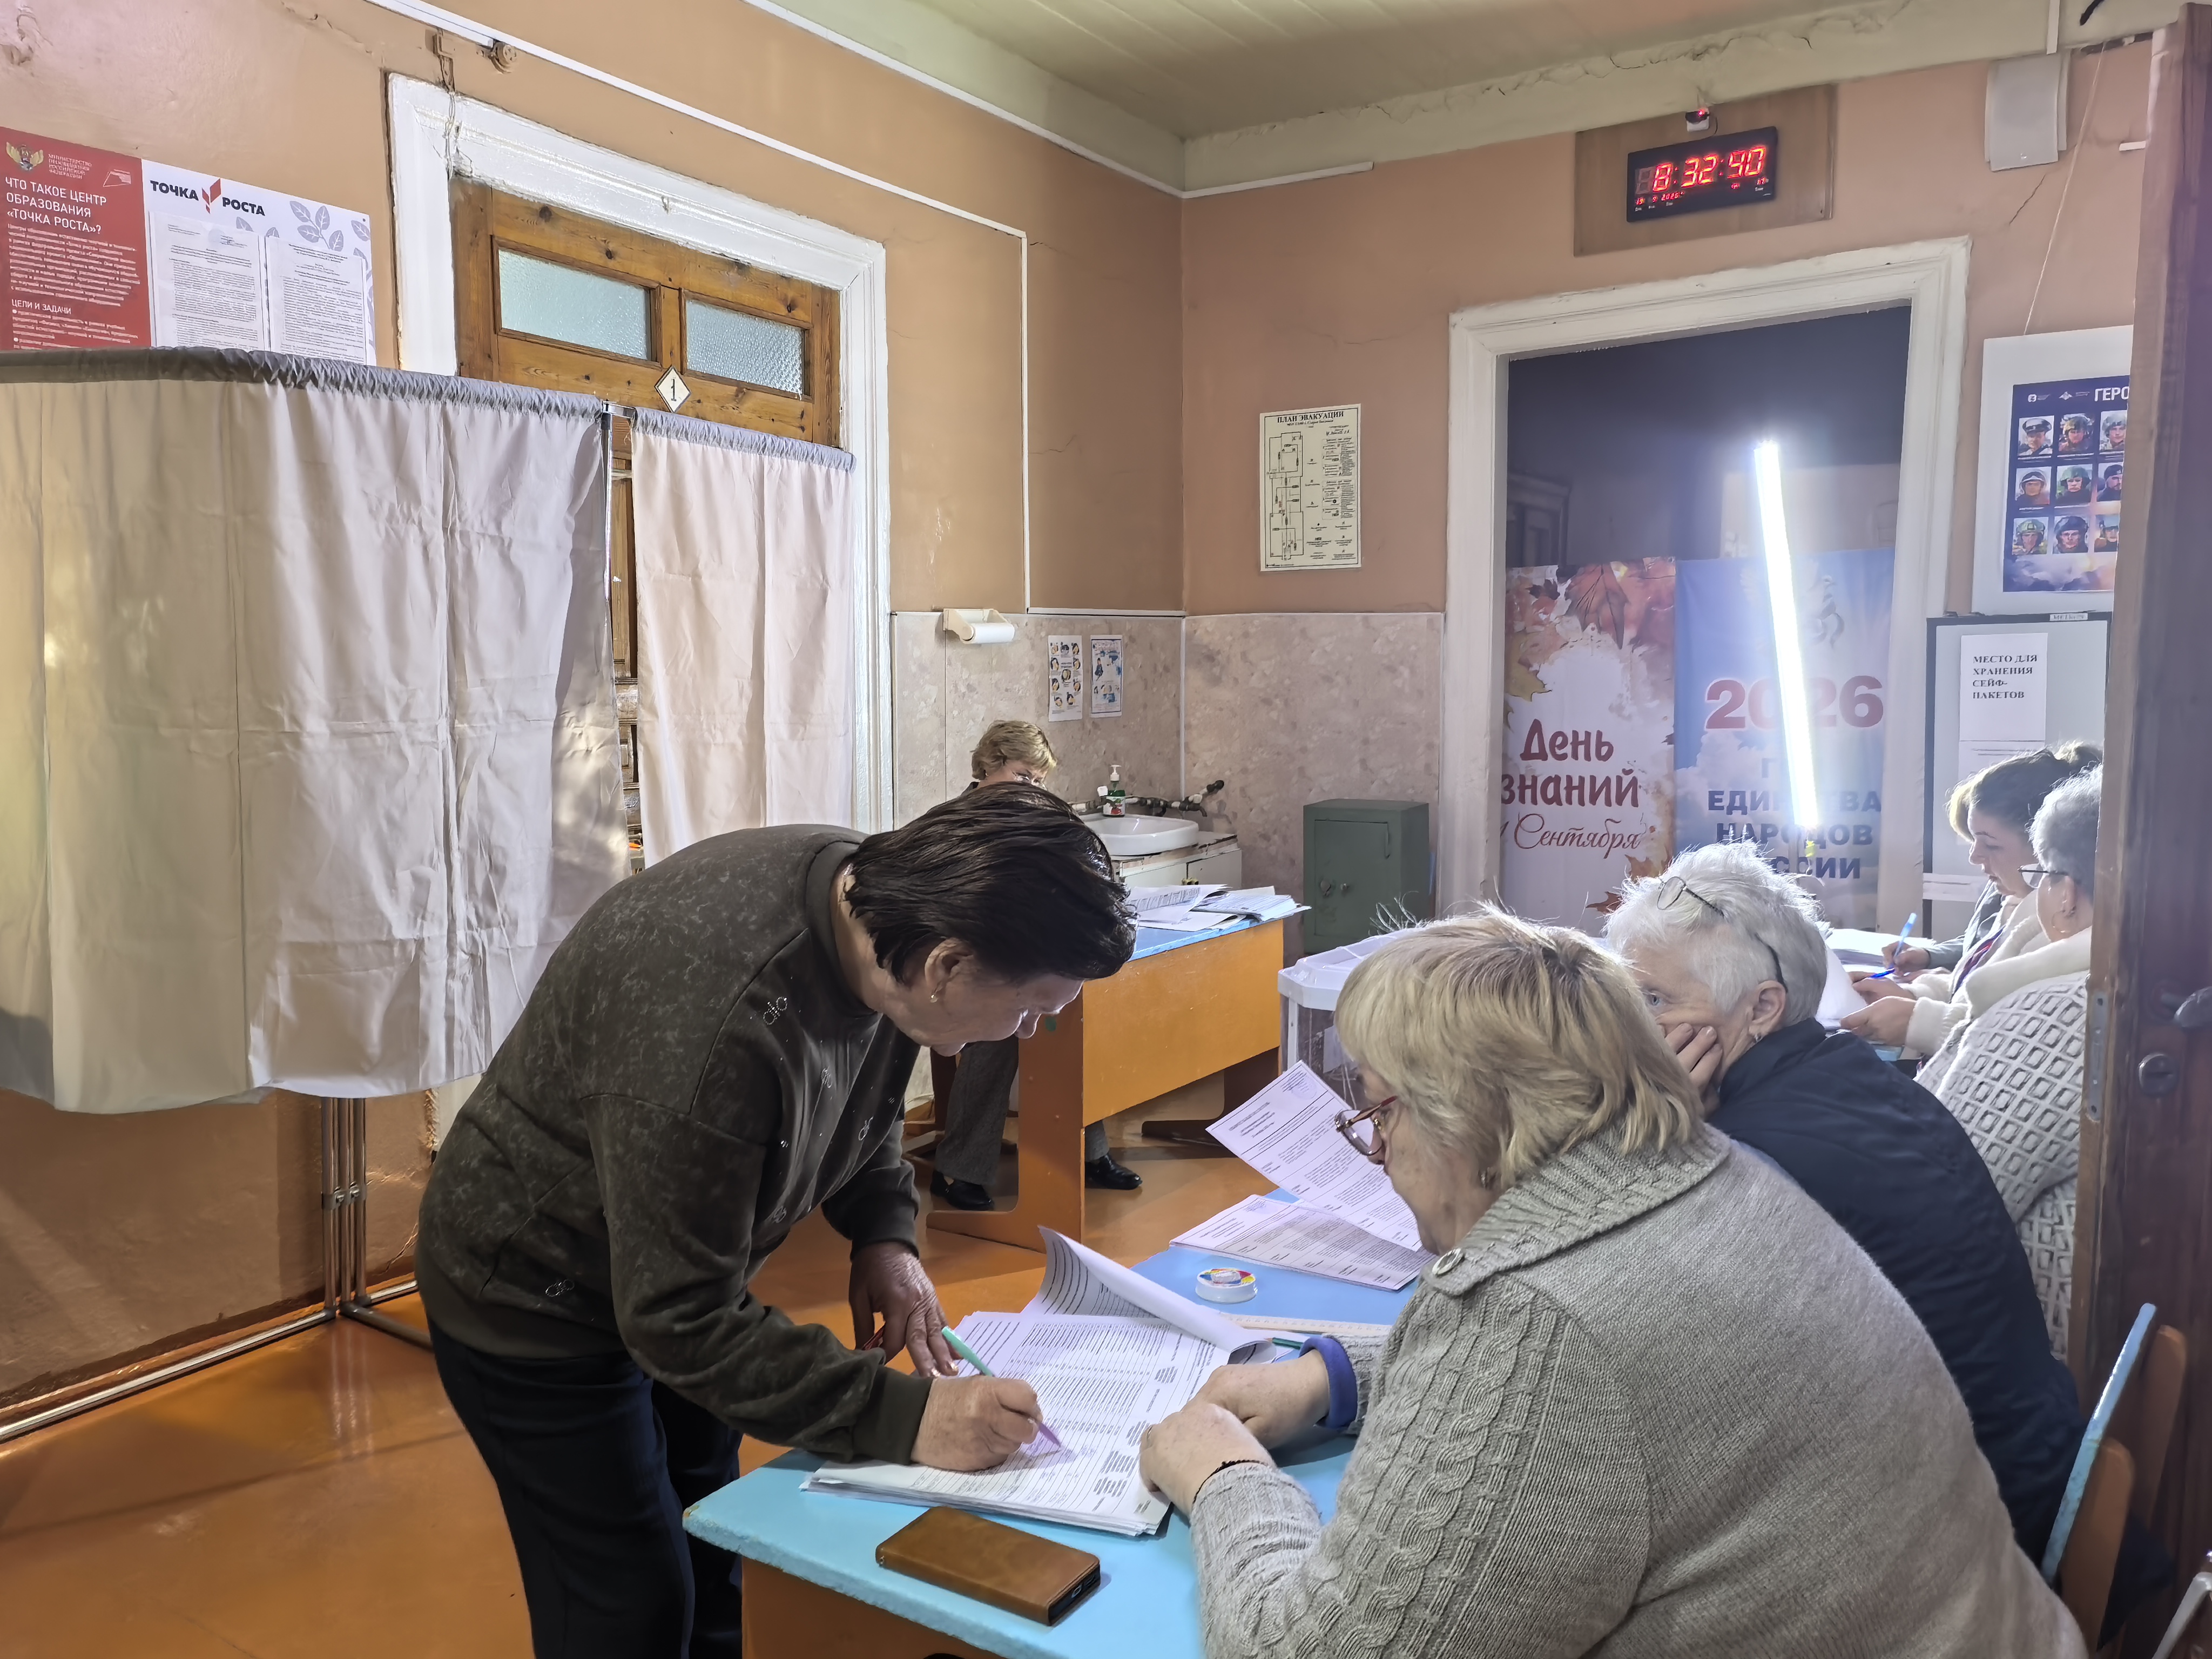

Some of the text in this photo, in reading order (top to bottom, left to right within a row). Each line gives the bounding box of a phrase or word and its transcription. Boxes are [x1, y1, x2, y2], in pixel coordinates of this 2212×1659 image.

[5, 176, 107, 206] ЧТО ТАКОЕ ЦЕНТР
[150, 180, 266, 217] ТОЧКА РОСТА
[6, 192, 91, 218] ОБРАЗОВАНИЯ
[7, 208, 102, 234] «ТОЧКА РОСТА»?
[12, 299, 32, 309] ЦЕЛИ
[42, 304, 72, 314] ЗАДАЧИ
[671, 378, 677, 402] 1
[1277, 410, 1344, 423] ПЛАН ЭВАКУАЦИИ
[1973, 655, 2038, 664] МЕСТО ДЛЯ
[1973, 667, 2033, 675] ХРАНЕНИЯ
[1972, 678, 2008, 687] СЕЙФ-
[1705, 675, 1884, 730] 2026
[1520, 718, 1614, 762] День
[1501, 768, 1639, 808] знаний
[1514, 812, 1643, 859] Сентября
